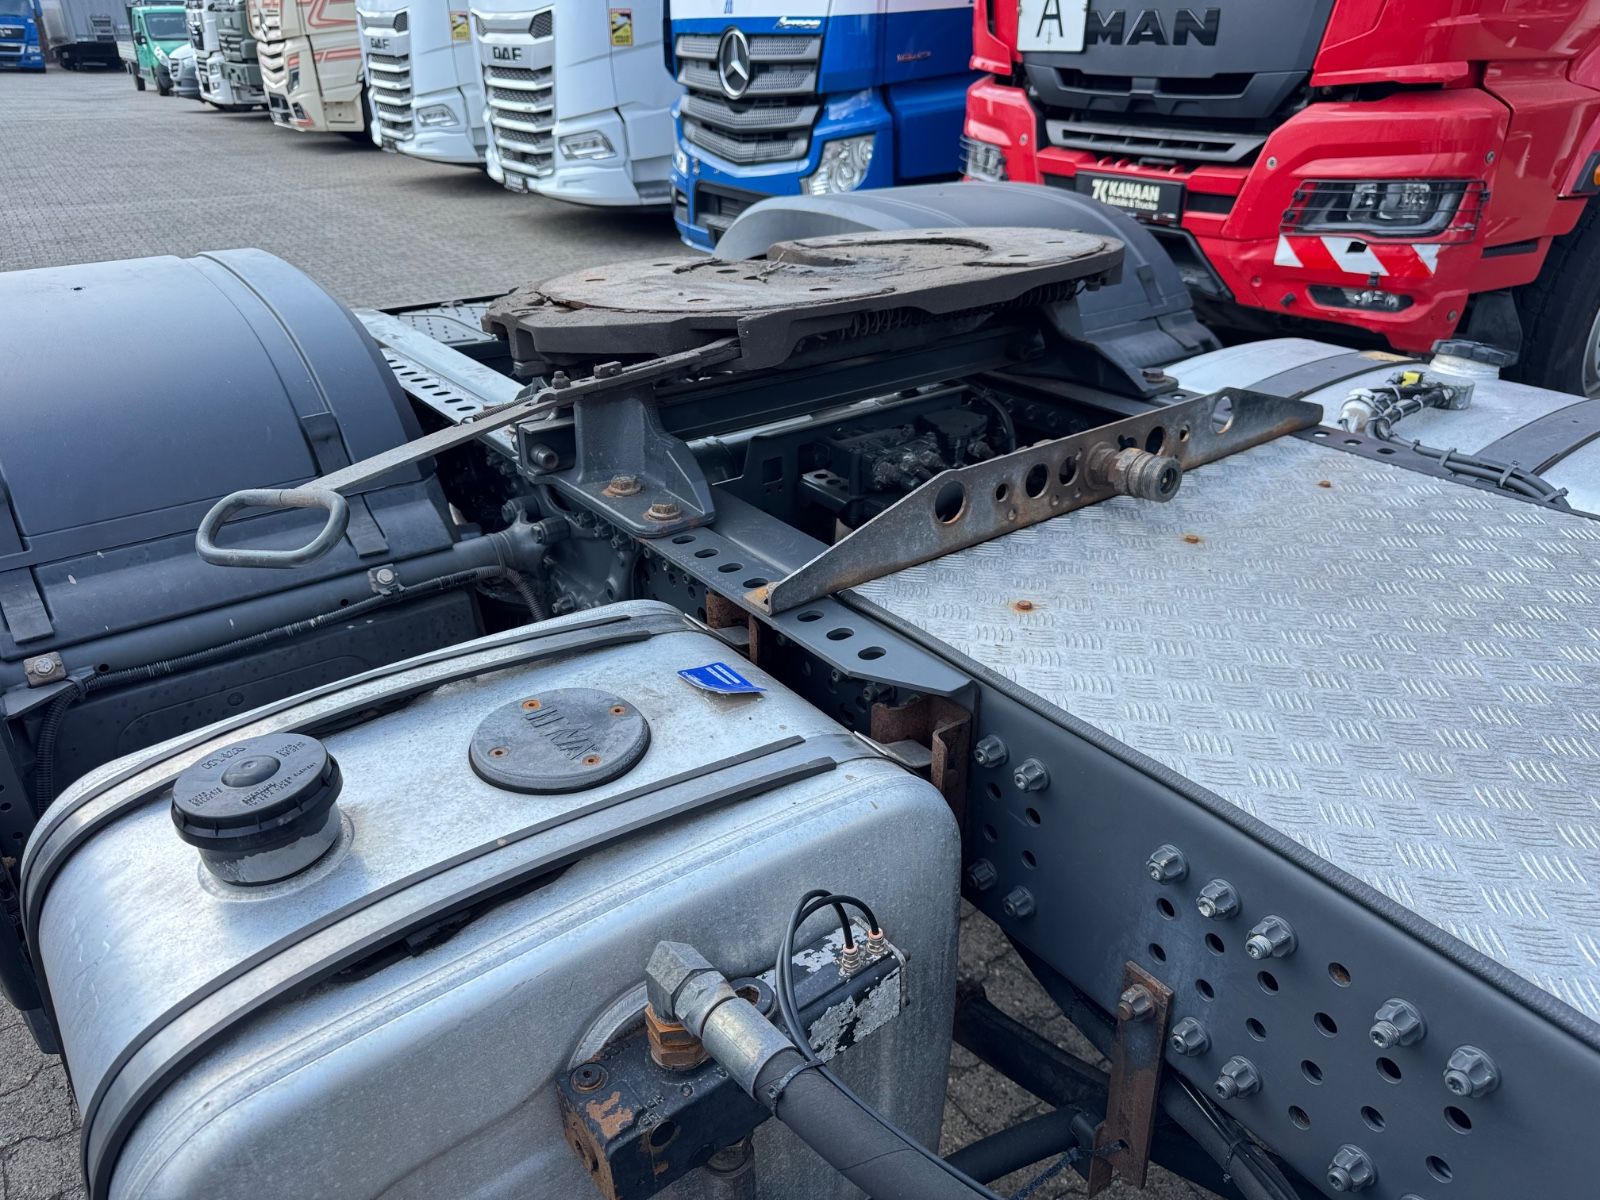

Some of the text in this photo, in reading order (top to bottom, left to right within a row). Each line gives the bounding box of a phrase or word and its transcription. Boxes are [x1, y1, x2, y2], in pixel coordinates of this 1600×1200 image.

[1036, 0, 1063, 37] A
[1087, 8, 1221, 46] MAN
[493, 46, 522, 60] DAF
[1108, 181, 1160, 202] KANAAN
